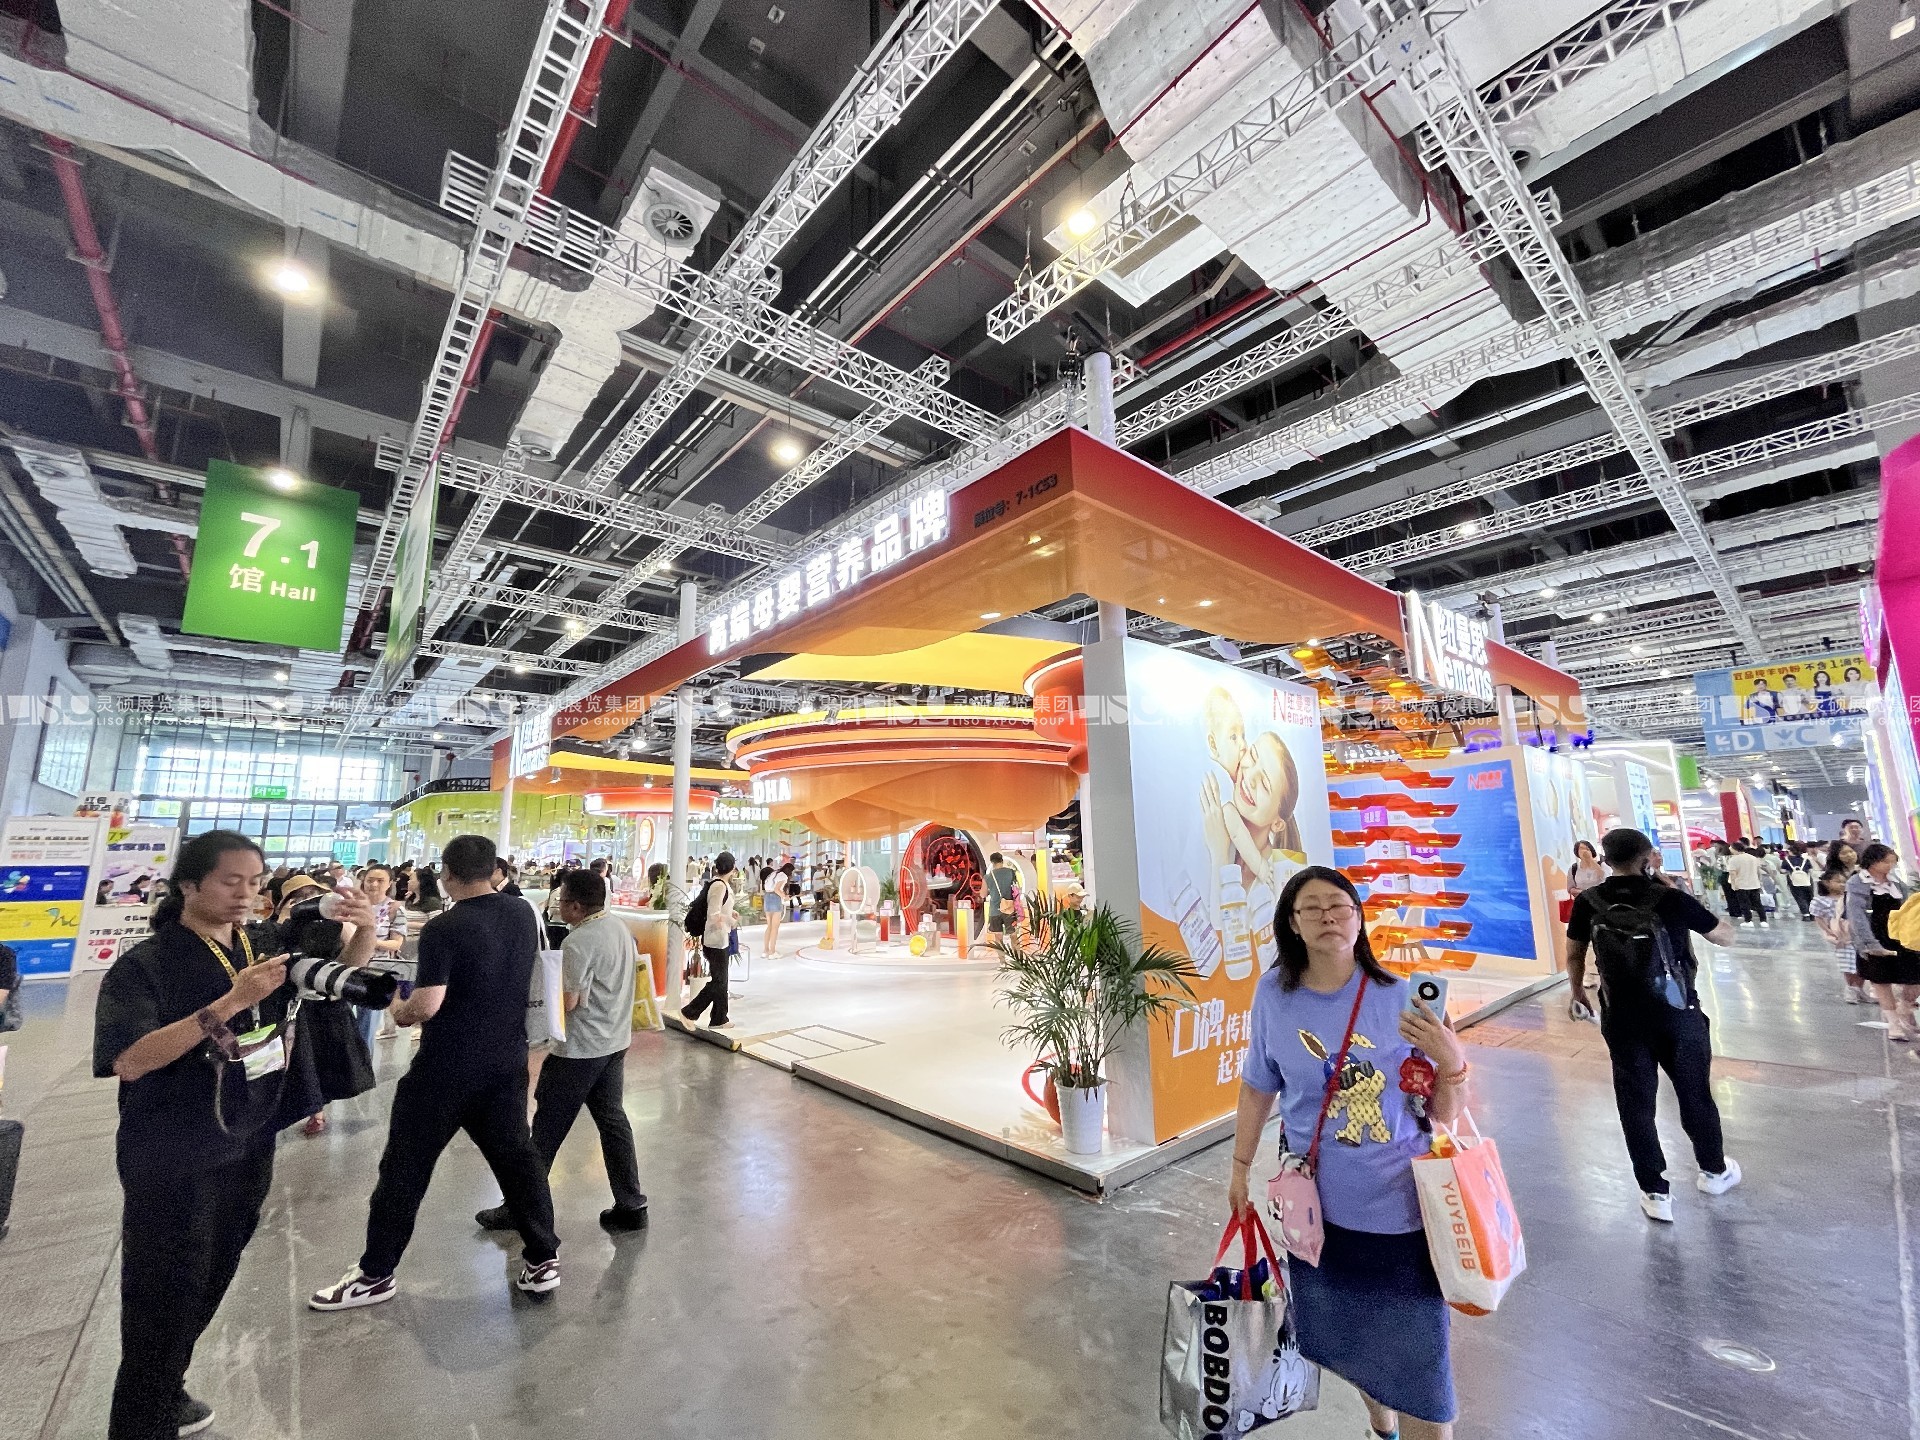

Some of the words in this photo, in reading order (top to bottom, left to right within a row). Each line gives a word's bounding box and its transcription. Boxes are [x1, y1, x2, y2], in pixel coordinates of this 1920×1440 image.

[240, 512, 319, 569] 7.1
[229, 563, 265, 593] 馆
[270, 580, 316, 602] Hall
[708, 488, 948, 656] 高端母婴营养品牌
[1732, 731, 1755, 750] D
[752, 777, 791, 804] DHA
[1202, 1304, 1230, 1440] BOBDO
